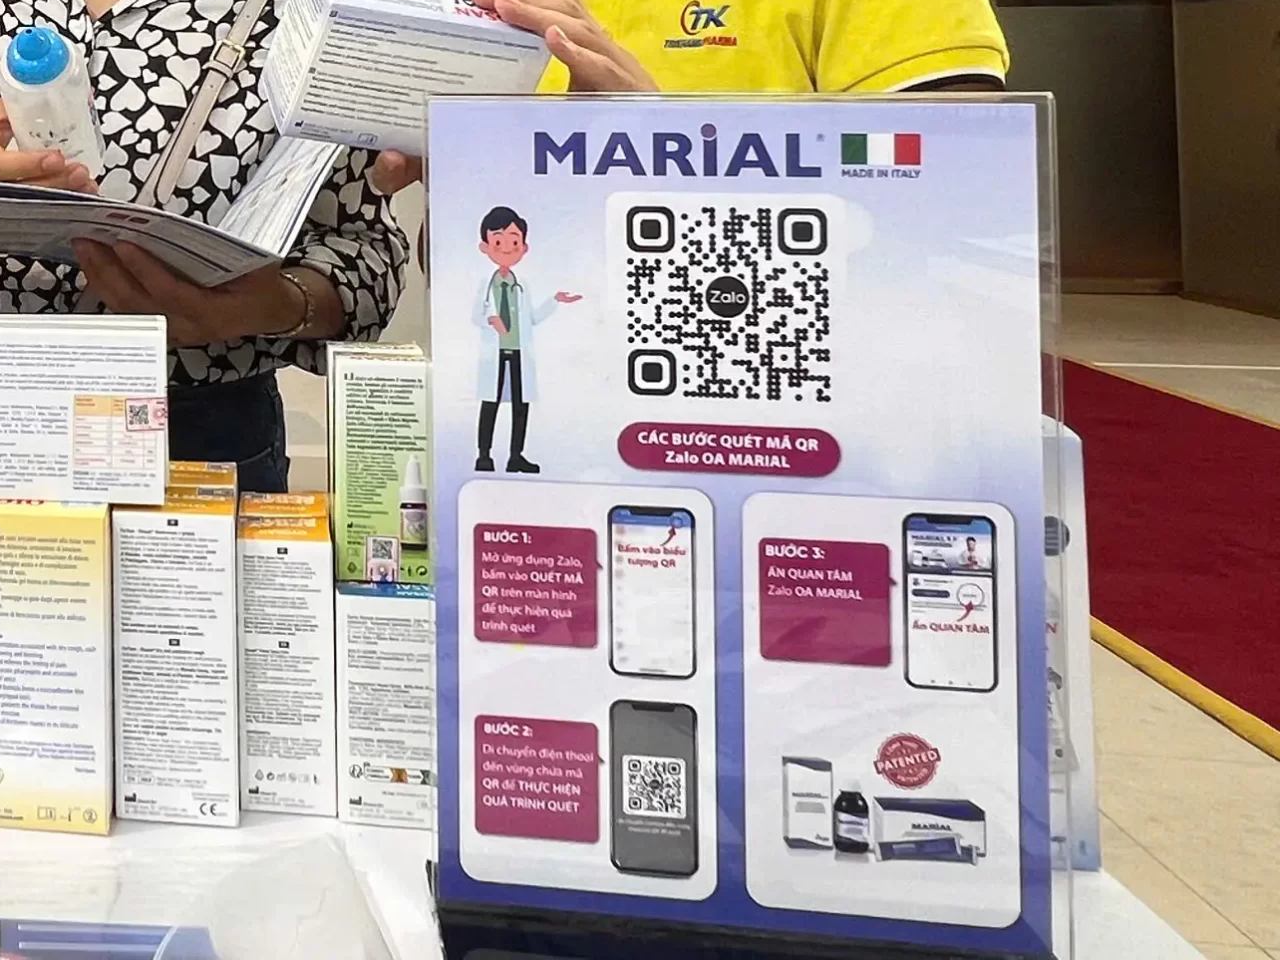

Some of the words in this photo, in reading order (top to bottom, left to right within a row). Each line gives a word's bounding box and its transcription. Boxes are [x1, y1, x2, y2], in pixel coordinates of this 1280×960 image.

[841, 169, 874, 179] MADE
[877, 170, 888, 179] IN
[891, 170, 921, 180] ITALY
[710, 290, 746, 304] Zalo
[637, 430, 668, 445] CÁC
[672, 431, 716, 447] BƯỚC
[719, 434, 763, 449] QUÉT
[795, 438, 819, 452] QR
[665, 450, 699, 464] Zalo
[702, 452, 725, 465] OA
[728, 454, 790, 468] MARIAL
[483, 529, 519, 543] BƯỚC
[521, 531, 532, 544] 1:
[765, 543, 809, 558] BƯỚC
[812, 546, 826, 559] 3:
[661, 558, 676, 568] QR
[787, 568, 824, 580] QUAN
[482, 585, 498, 597] QR
[767, 584, 793, 596] Zalo
[794, 586, 814, 597] OA
[816, 587, 863, 601] MARIAL
[484, 722, 520, 736] BƯỚC
[522, 725, 533, 737] 2:
[482, 743, 495, 755] Di
[876, 750, 938, 772] PATENTED
[482, 777, 499, 790] QR
